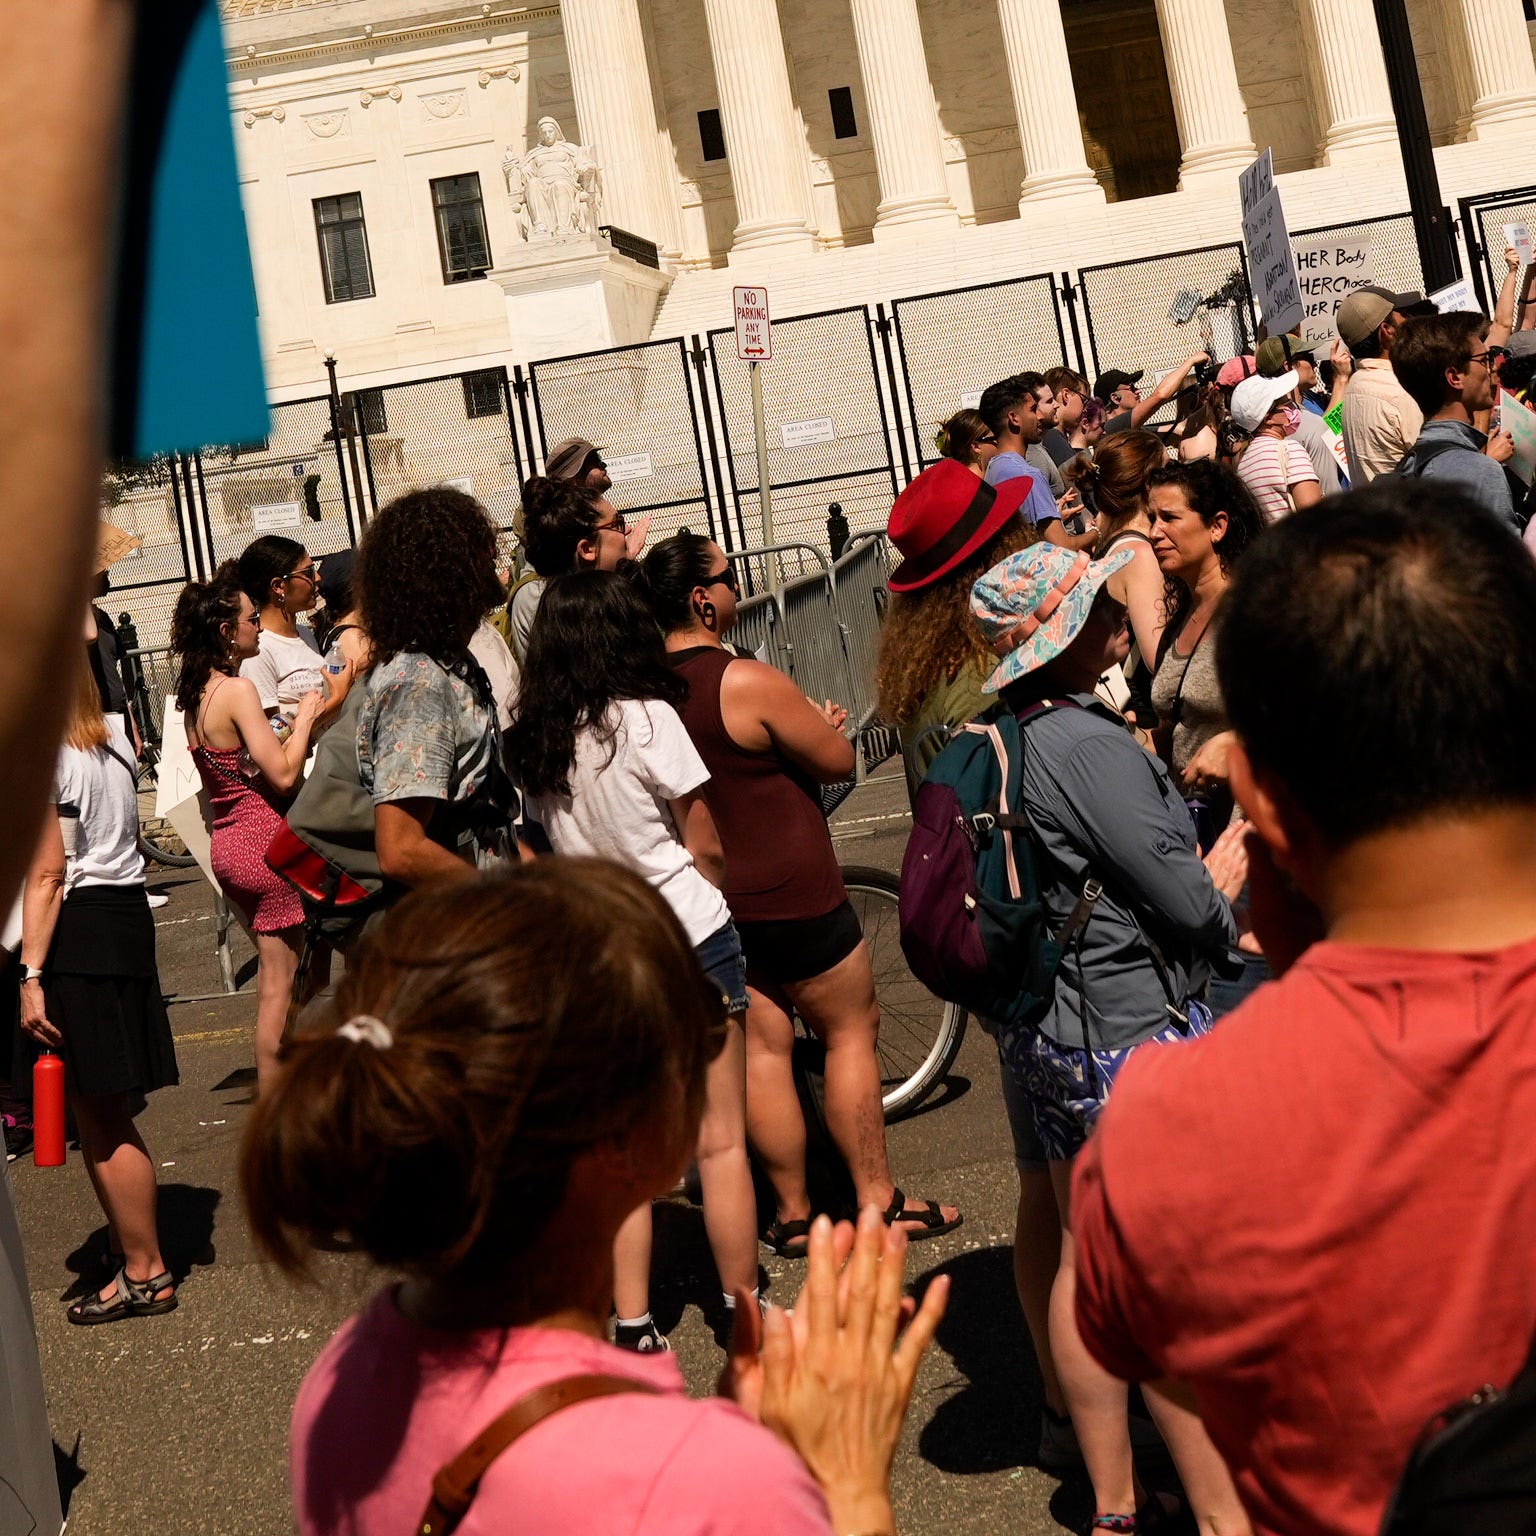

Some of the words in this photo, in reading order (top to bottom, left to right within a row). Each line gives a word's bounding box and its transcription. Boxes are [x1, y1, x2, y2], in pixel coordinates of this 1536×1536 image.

[1297, 249, 1331, 271] HER
[1335, 248, 1367, 269] Body
[1299, 276, 1333, 296] HER
[1332, 275, 1372, 293] Choice
[743, 292, 757, 306] NO
[737, 306, 767, 320] PARKING
[745, 322, 760, 333] ANY
[1305, 327, 1336, 342] Fuck
[745, 334, 762, 345] TIME
[786, 425, 803, 433] AREA
[804, 421, 828, 430] CLOSED
[624, 456, 647, 465] CLOSED
